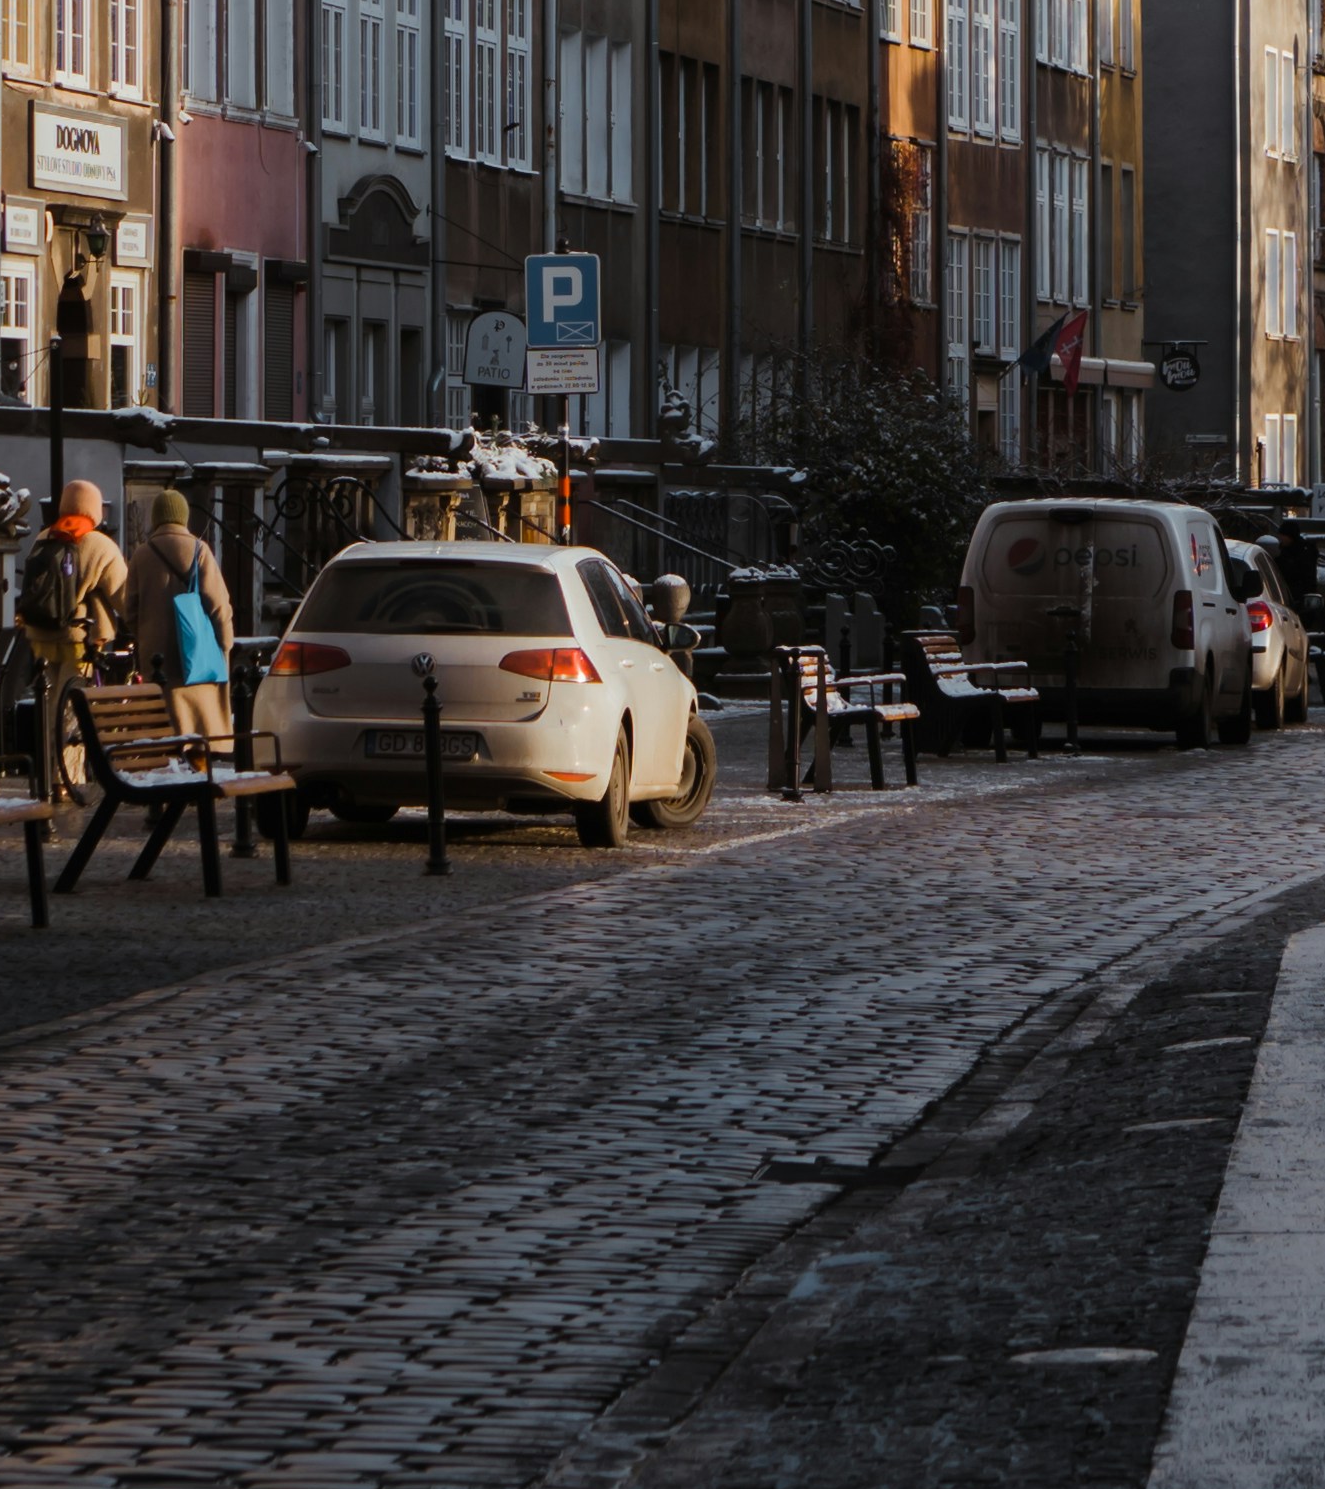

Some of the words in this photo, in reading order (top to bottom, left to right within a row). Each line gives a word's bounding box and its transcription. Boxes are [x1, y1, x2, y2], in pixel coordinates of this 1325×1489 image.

[56, 124, 101, 155] DOGNOVA
[542, 266, 583, 323] P
[477, 366, 511, 380] PATIO
[1054, 544, 1137, 572] pepsi
[378, 733, 406, 753] GD
